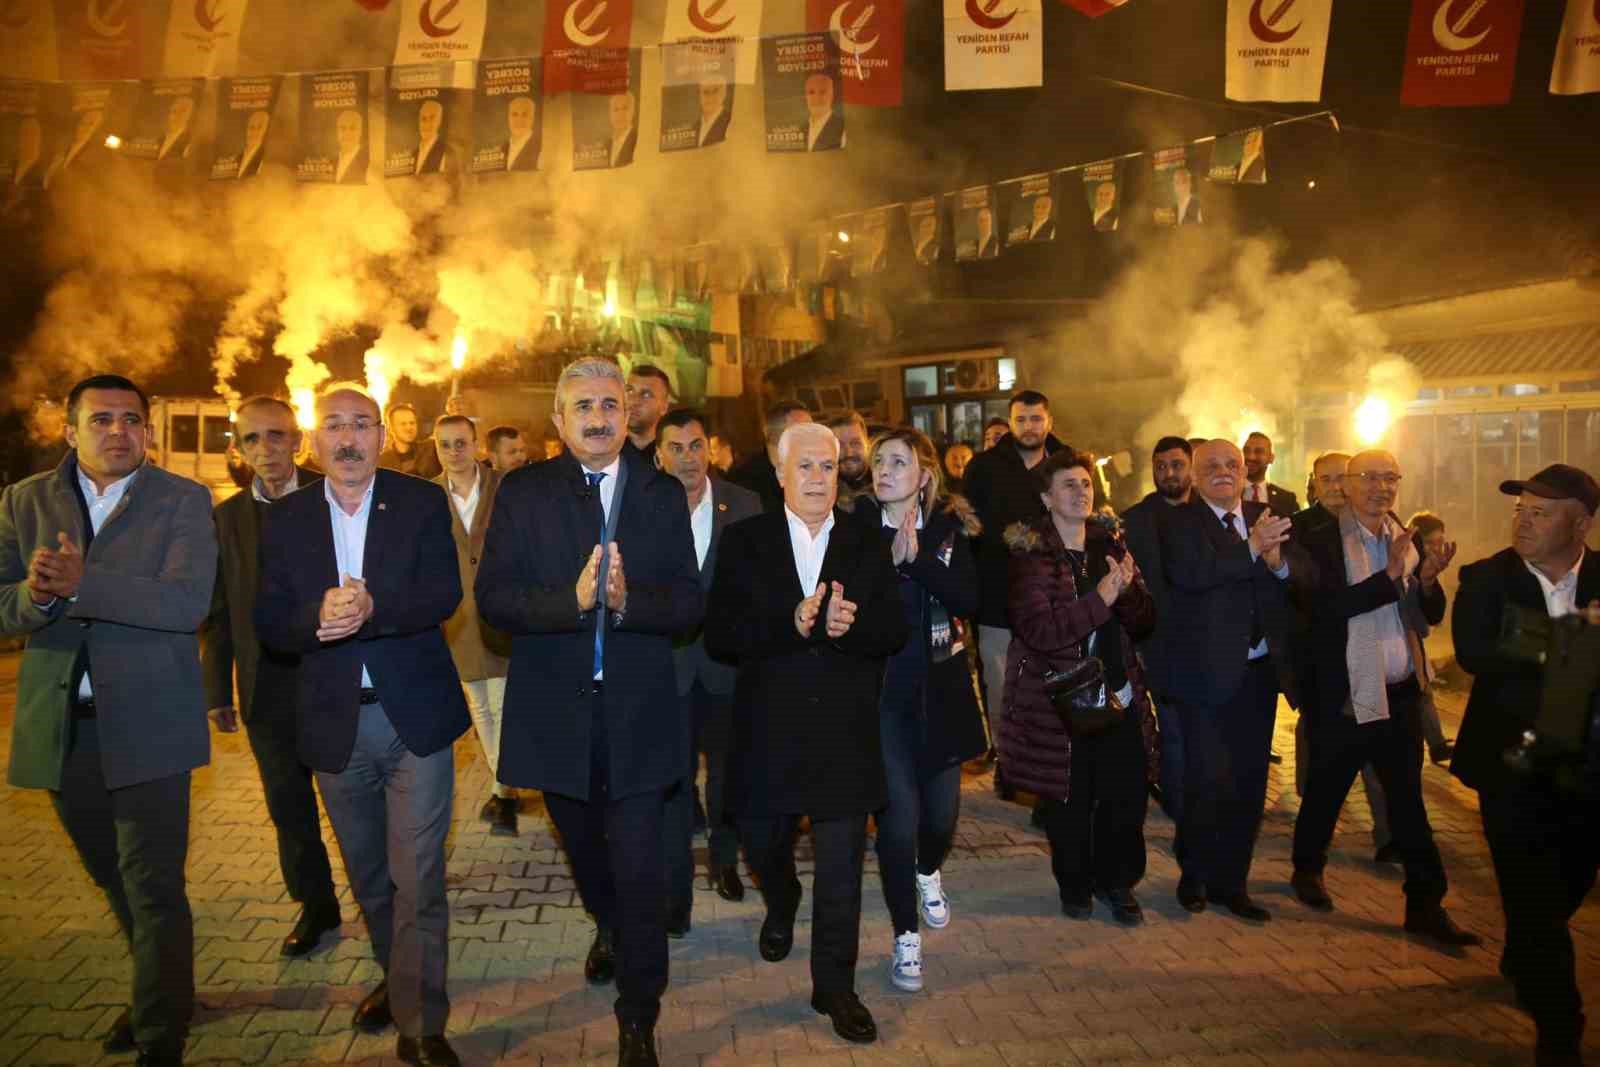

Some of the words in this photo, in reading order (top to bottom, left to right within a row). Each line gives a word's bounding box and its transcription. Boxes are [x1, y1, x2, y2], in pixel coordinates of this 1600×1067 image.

[999, 31, 1029, 41] REFAH
[1279, 47, 1310, 56] REFAH
[1465, 53, 1498, 63] REFAH
